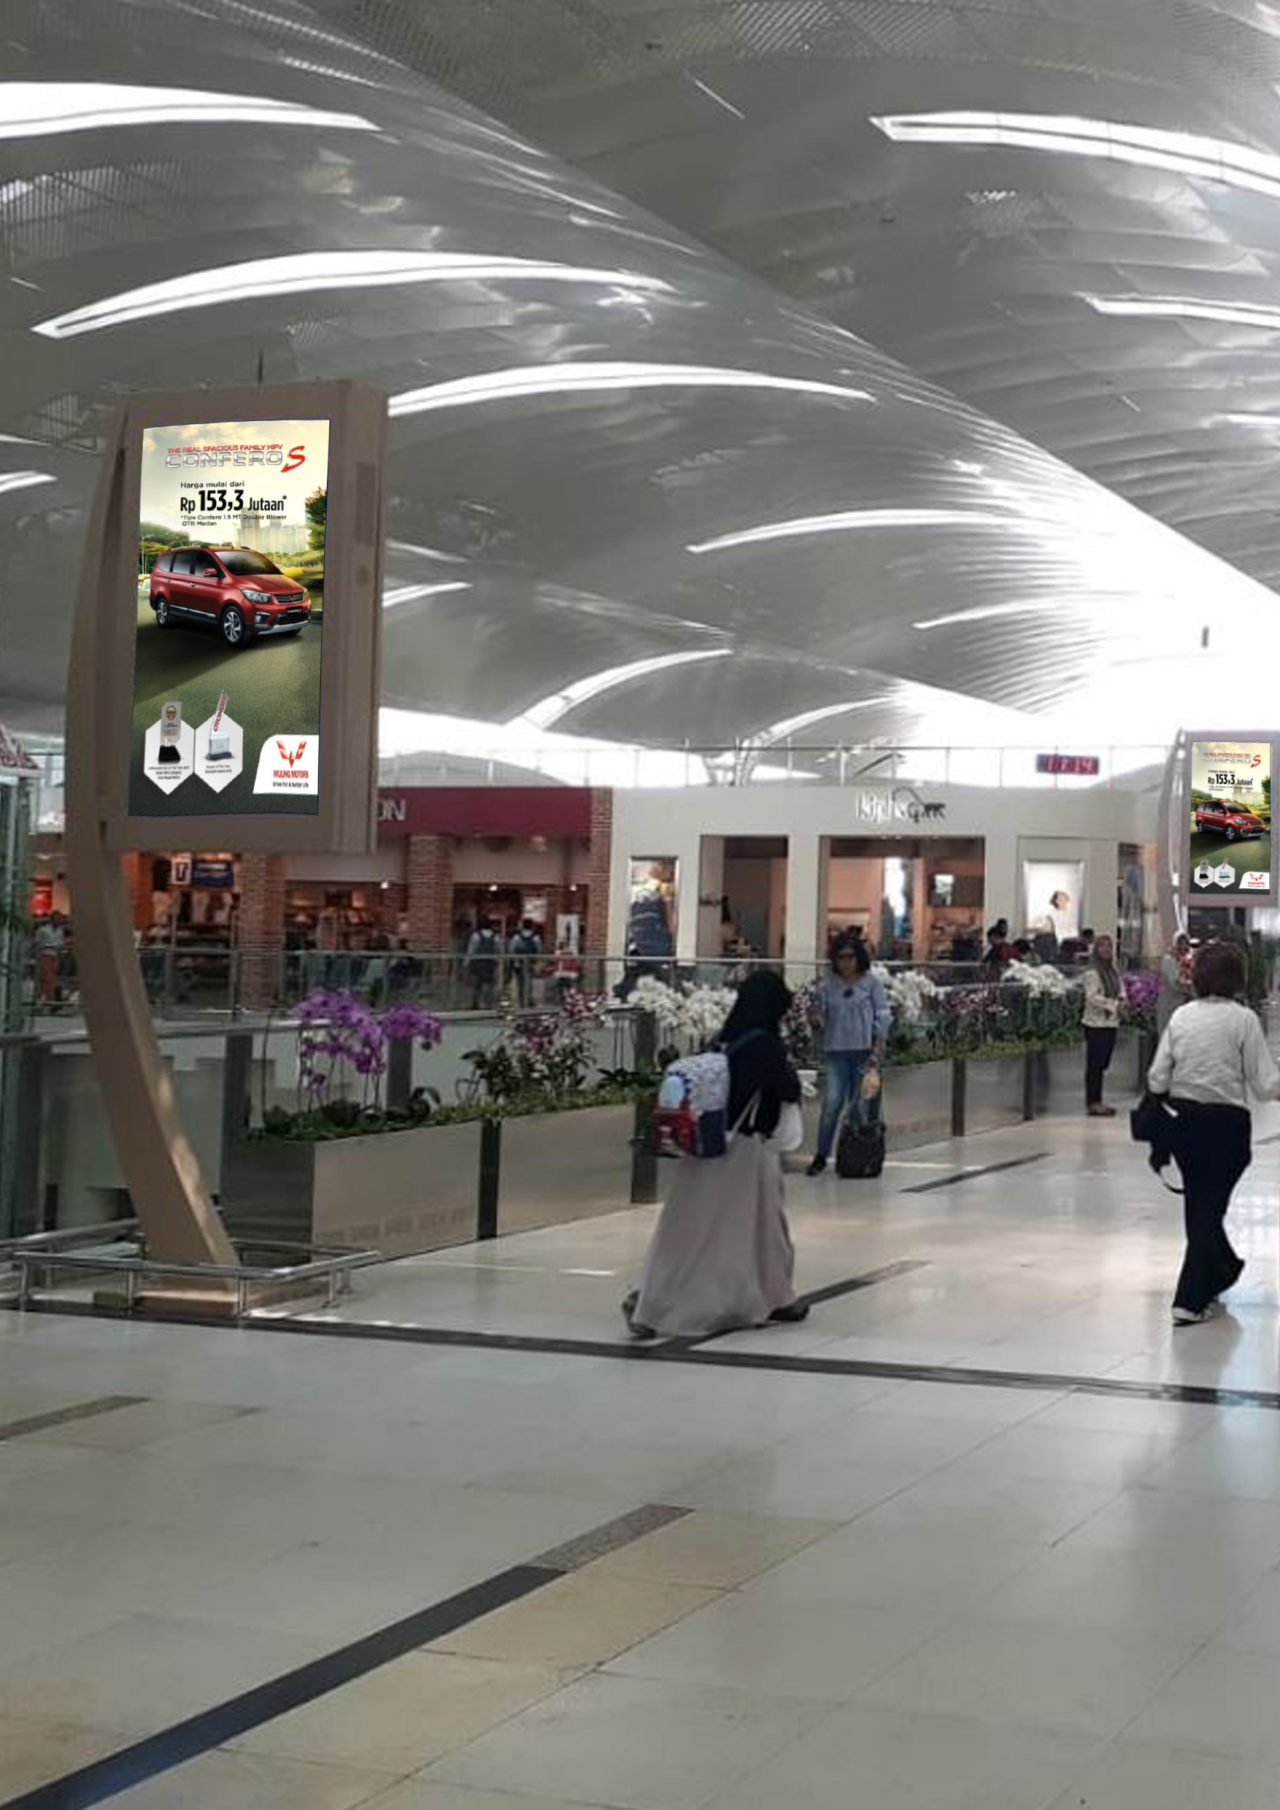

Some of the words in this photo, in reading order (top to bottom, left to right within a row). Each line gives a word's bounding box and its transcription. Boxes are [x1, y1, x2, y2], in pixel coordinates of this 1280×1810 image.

[165, 451, 283, 468] CONFERO
[280, 445, 306, 472] S
[180, 481, 204, 489] Harga
[180, 497, 196, 514] Rp
[198, 489, 244, 512] 153,3
